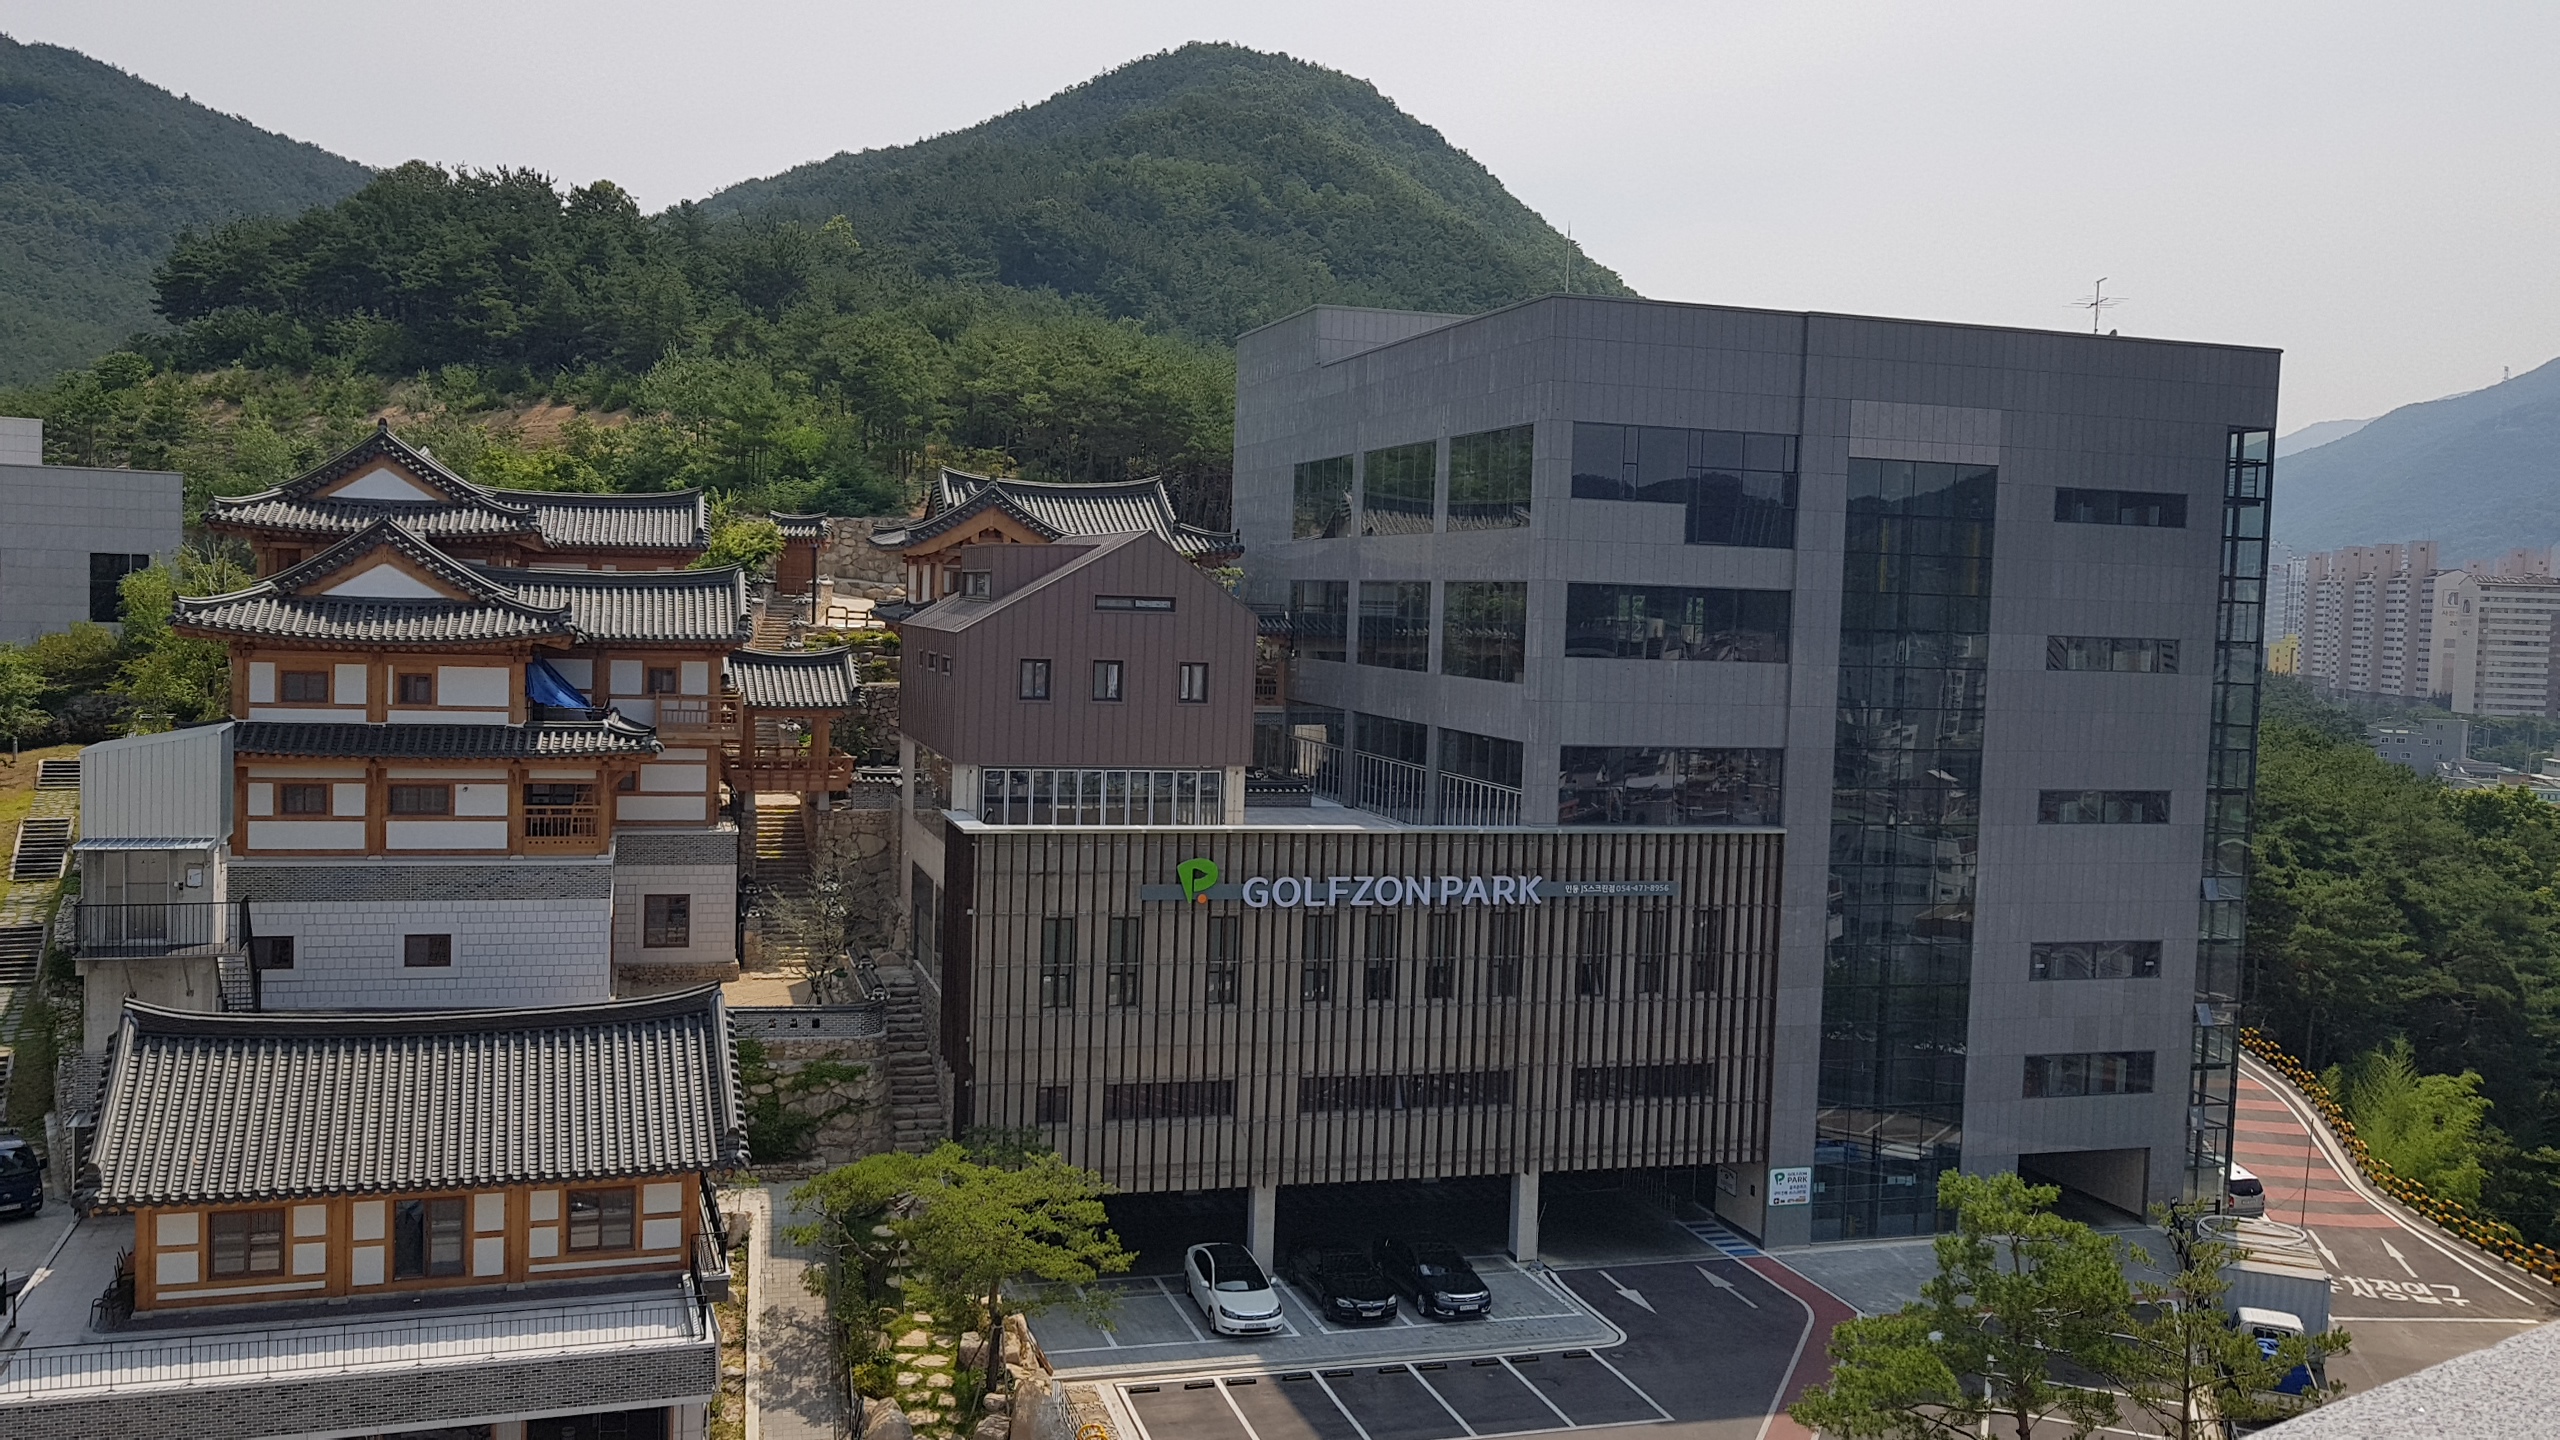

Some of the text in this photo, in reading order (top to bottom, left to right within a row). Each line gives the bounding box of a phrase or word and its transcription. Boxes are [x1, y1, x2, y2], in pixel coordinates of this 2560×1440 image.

[1242, 875, 1543, 908] GOLFZON PARK
[1616, 884, 1669, 893] 054-471-8956
